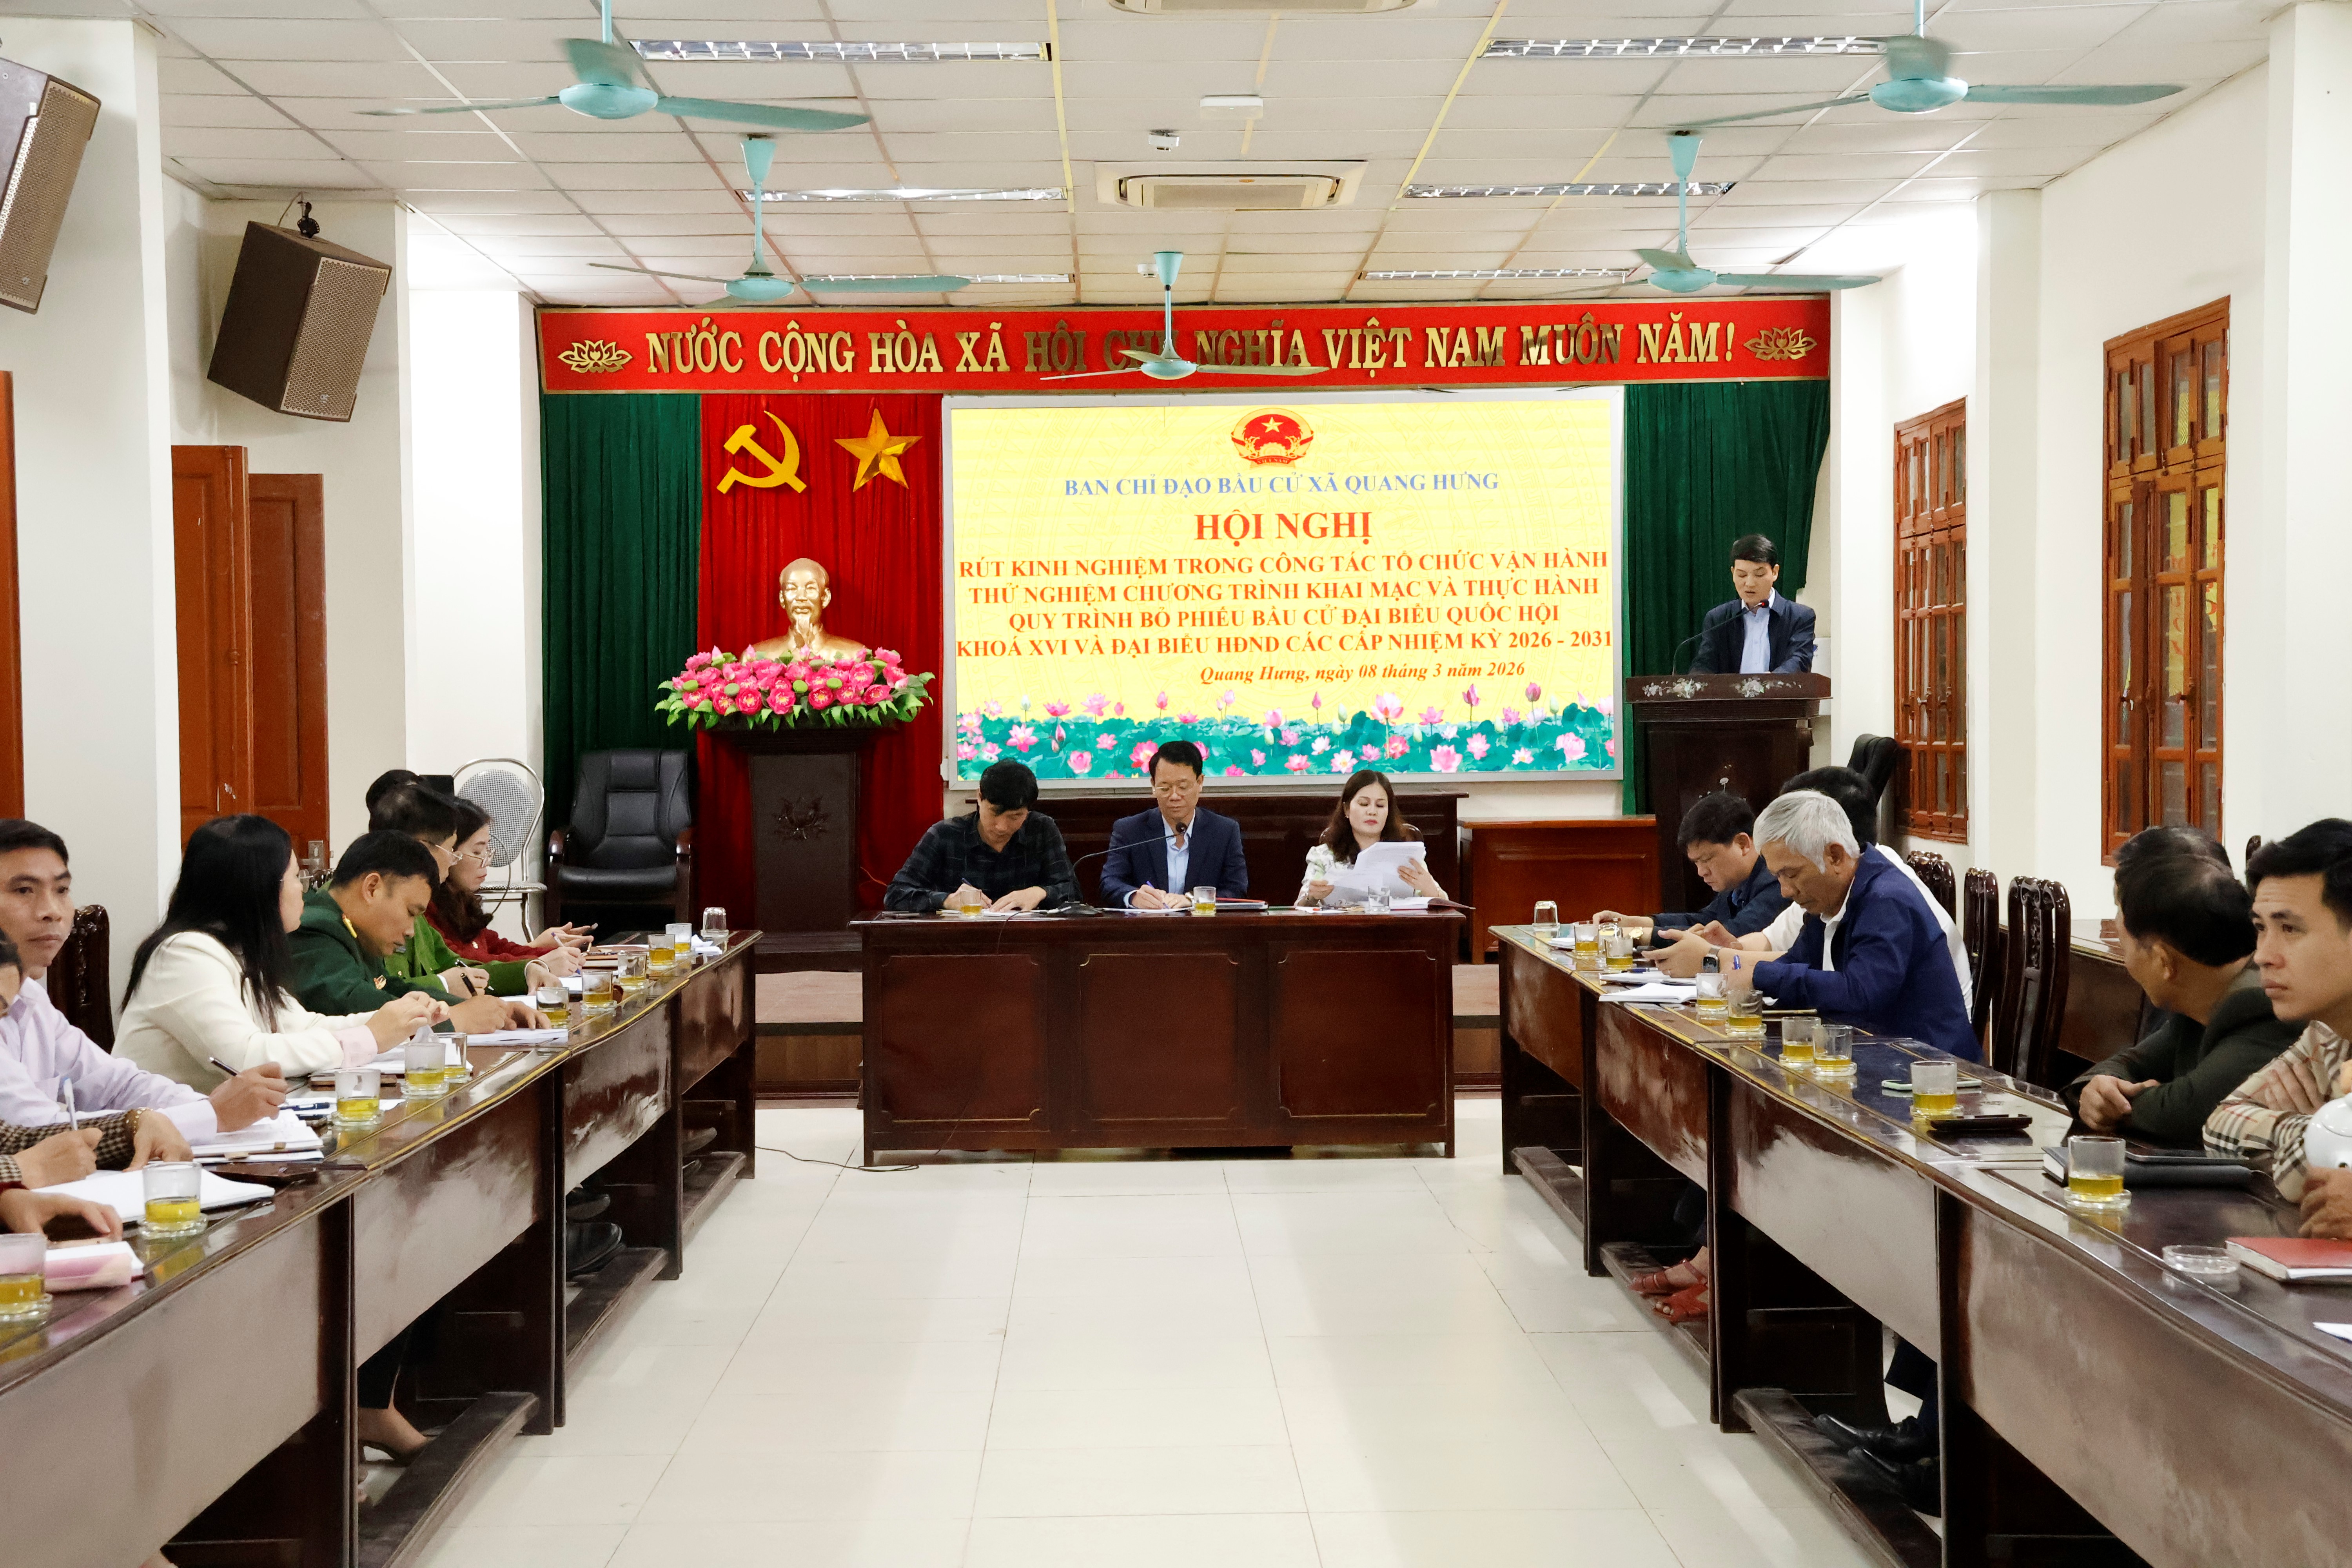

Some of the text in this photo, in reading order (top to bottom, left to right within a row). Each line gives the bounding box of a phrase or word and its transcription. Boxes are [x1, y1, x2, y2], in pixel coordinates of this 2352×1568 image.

[646, 317, 743, 373] NƯỚC
[759, 320, 855, 383] CỘNG
[868, 319, 943, 373] HÒA
[955, 322, 1010, 372] XÃ
[1024, 319, 1087, 381] HỘI
[1194, 319, 1311, 367] NGHĨA
[1322, 316, 1412, 378] VIỆT
[1425, 326, 1506, 367] NAM
[1519, 312, 1624, 365] MUÔN
[1065, 472, 1499, 498] BAN CHỈ ĐẠO BẦU CỬ XÃ QUANG HƯNG
[1194, 509, 1373, 547] HỘI NGHỊ
[959, 548, 1608, 579] RÚT KINH NGHIỆM TRONG CÔNG TÁC TỔ CHỨC VẬN HÀNH
[969, 574, 1599, 606] THỬ NGHIỆM CHƯƠNG TRÌNH KHAI MẠC VÀ THỰC HÀNH
[1009, 602, 1560, 632] QUY TRÌNH BỎ PHIẾU BẦU CỬ ĐẠI BIỂU QUỐC HỘI
[955, 636, 1023, 657] KHOÁ
[1029, 639, 1068, 655] XVI
[1074, 634, 1104, 654] VÀ
[1111, 638, 1149, 658] ĐẠI
[1157, 633, 1209, 654] BIỂU
[1216, 636, 1279, 653] HĐND
[1286, 631, 1332, 652] CÁC
[1339, 630, 1383, 651] CẤP
[1388, 631, 1463, 653] NHIỆM
[1471, 628, 1502, 648] KỲ
[1508, 632, 1552, 648] 2026
[1570, 631, 1612, 646] 2031
[1200, 661, 1525, 684] Quang Hưng, ngày 08 tháng 3 năm 2026
